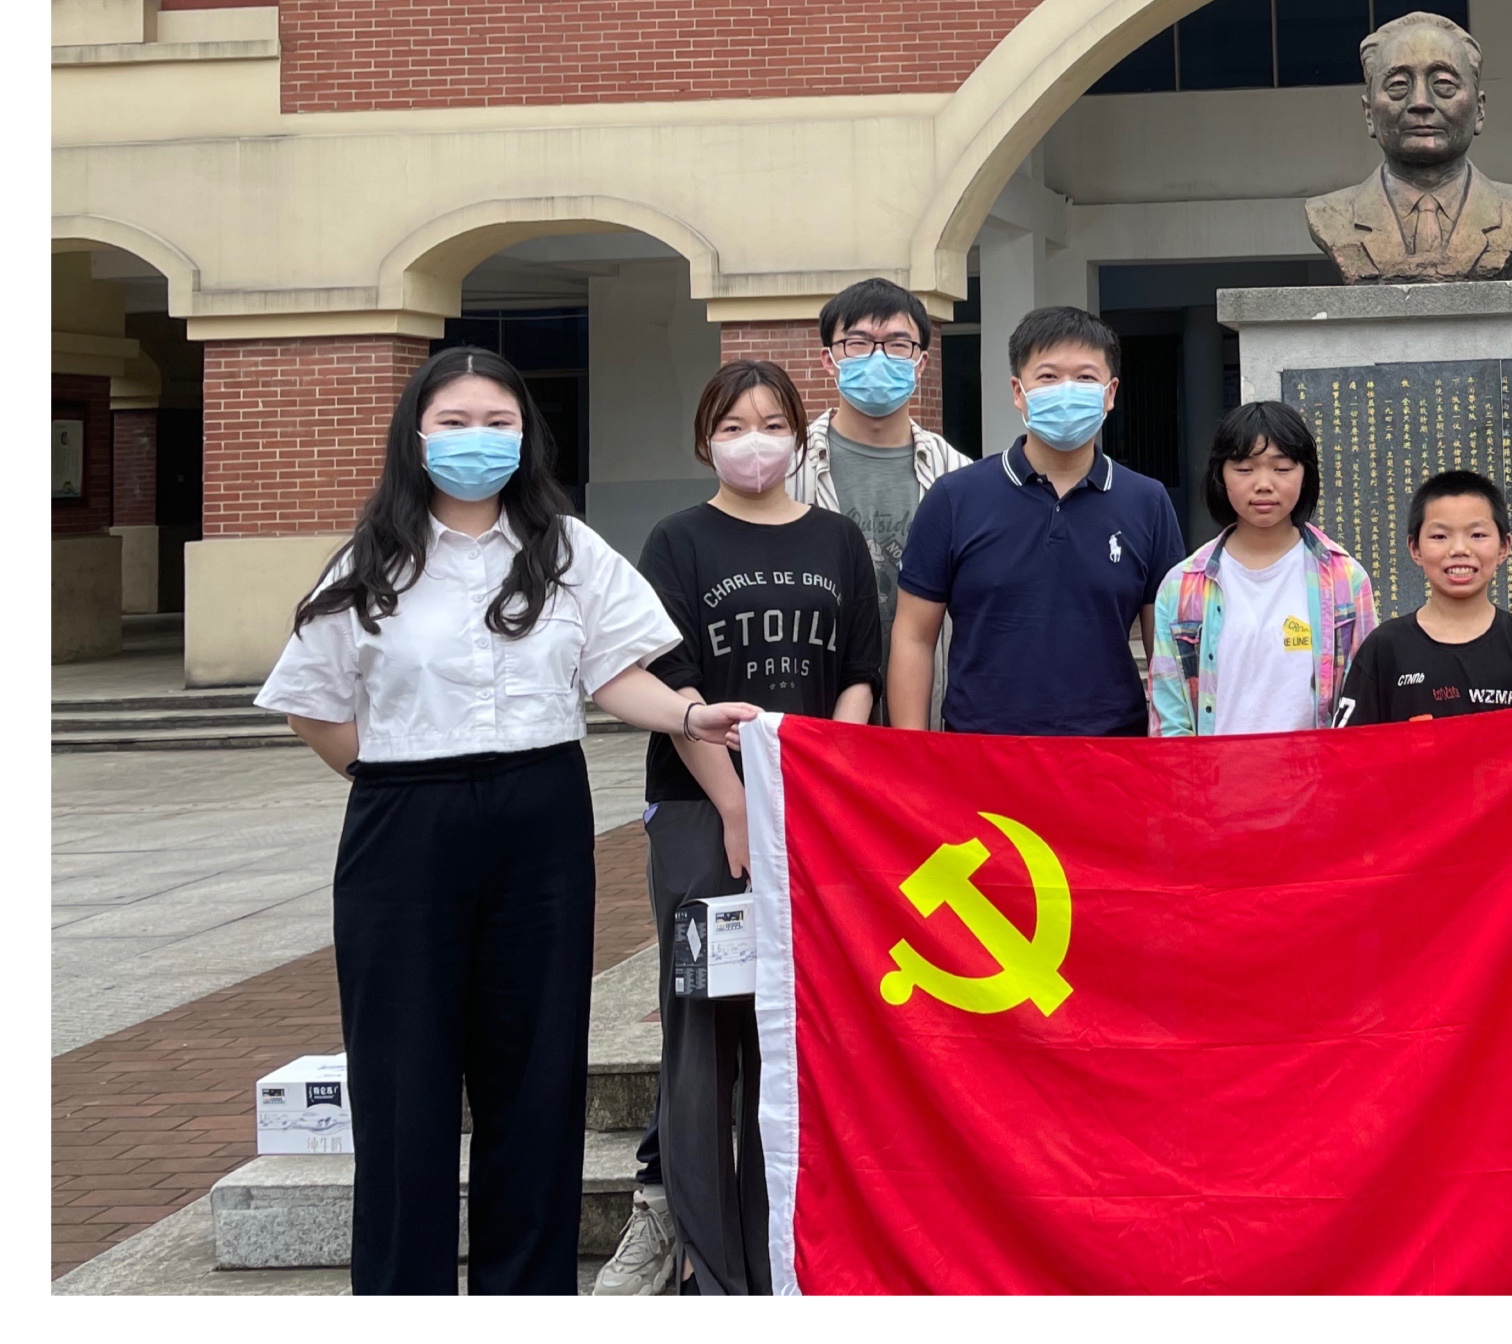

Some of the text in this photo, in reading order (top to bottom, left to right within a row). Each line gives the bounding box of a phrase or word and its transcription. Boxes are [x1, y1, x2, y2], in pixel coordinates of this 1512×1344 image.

[703, 571, 767, 608] CHARLE
[773, 571, 795, 585] DE
[1292, 636, 1309, 647] LINE
[747, 657, 810, 679] PARIS
